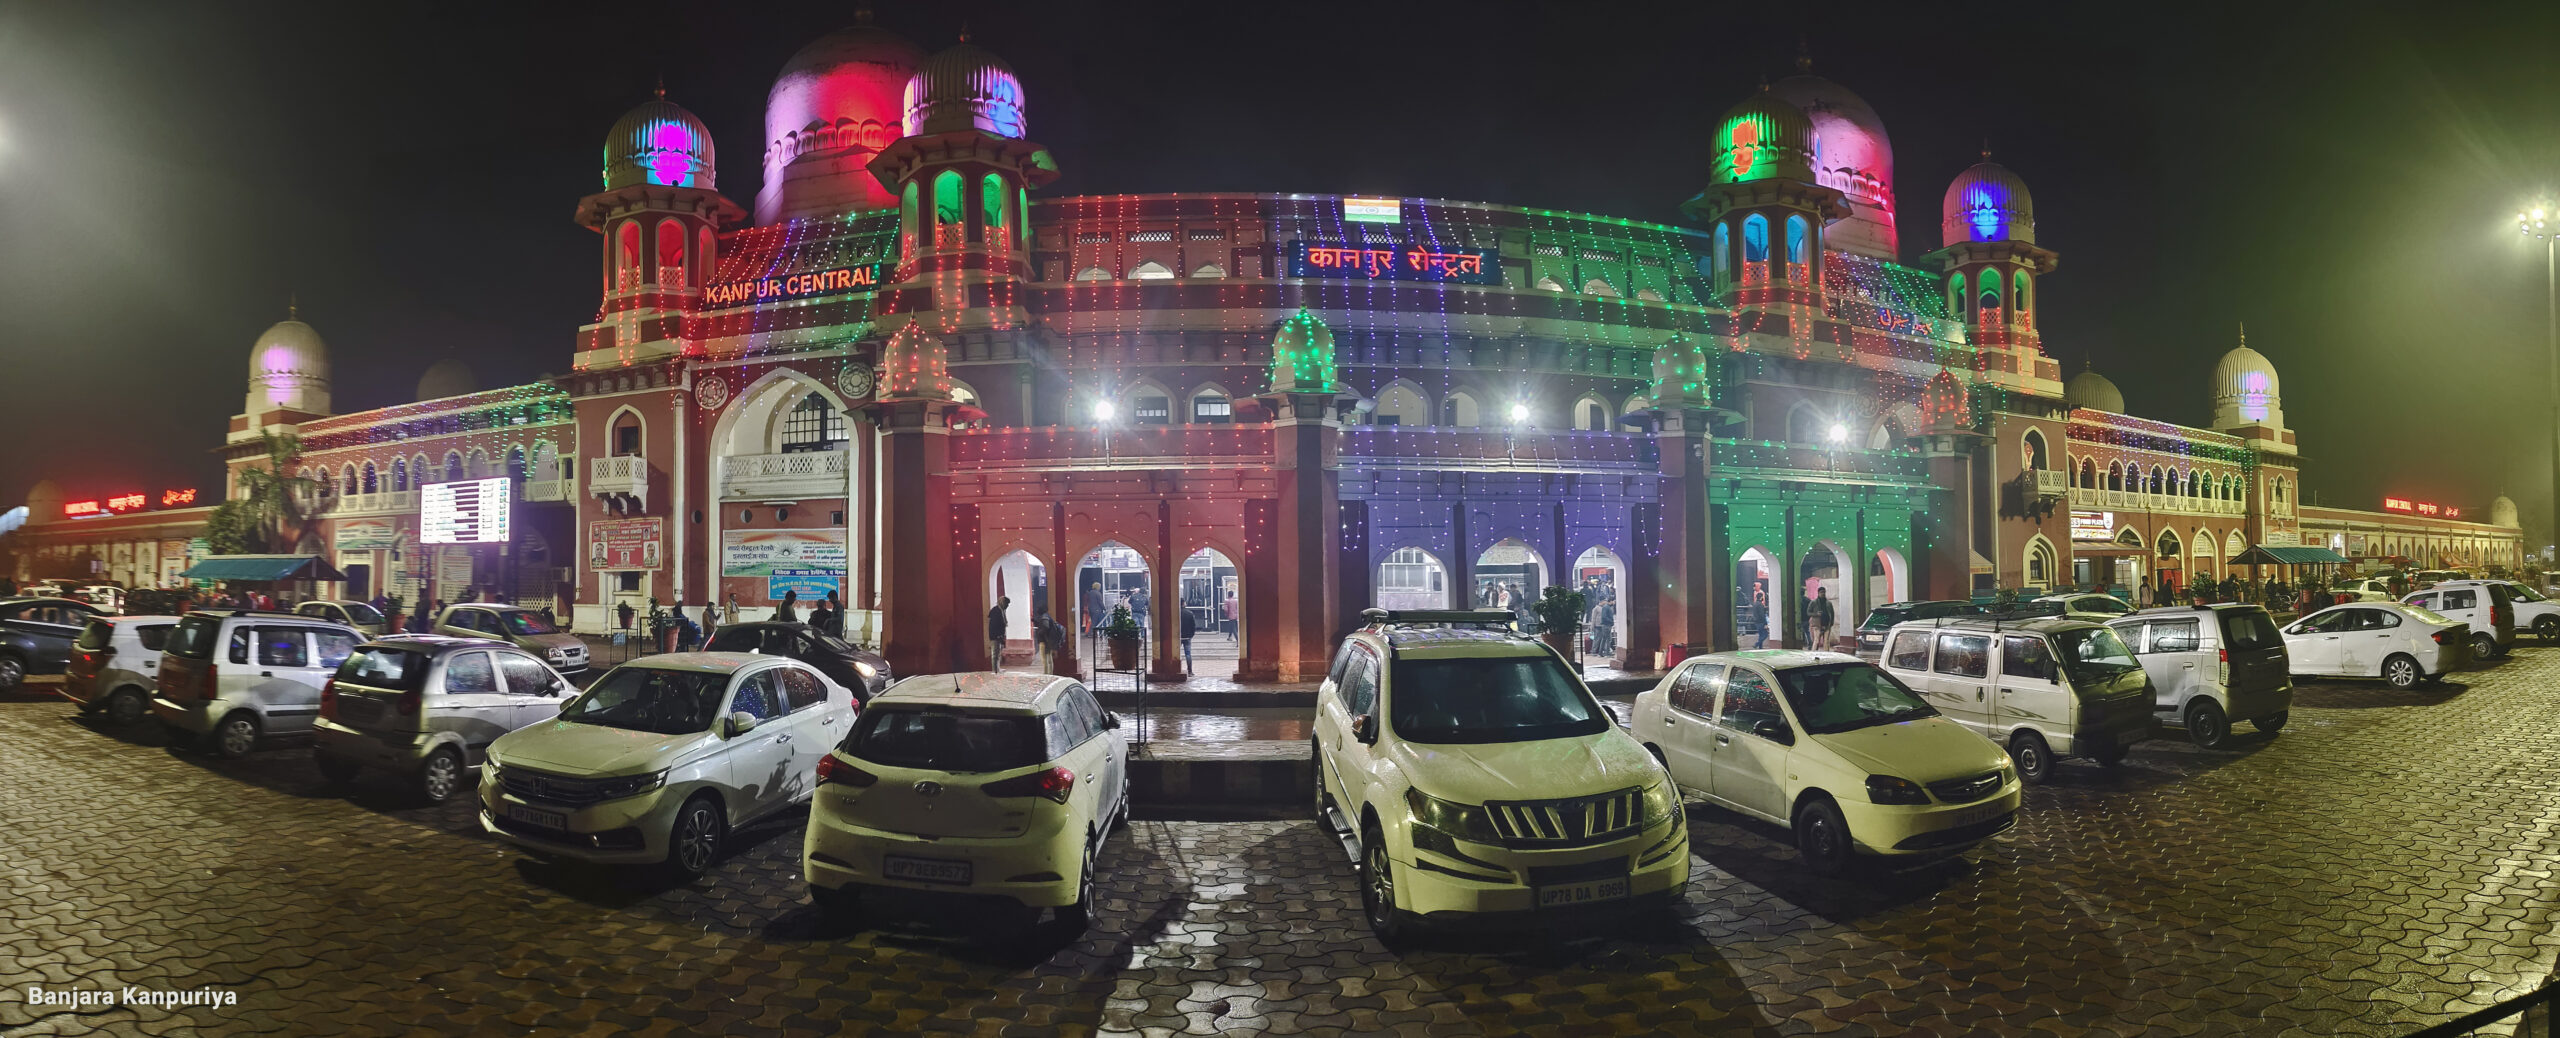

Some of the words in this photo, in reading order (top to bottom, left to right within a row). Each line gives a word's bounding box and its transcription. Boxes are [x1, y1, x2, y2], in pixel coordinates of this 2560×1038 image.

[1308, 247, 1394, 278] कानपुर
[1407, 245, 1482, 278] सेन्ट्रल
[706, 279, 782, 304] KANPUR
[786, 266, 878, 295] CENTRAL
[1542, 889, 1572, 904] UP78
[1576, 887, 1592, 901] DA
